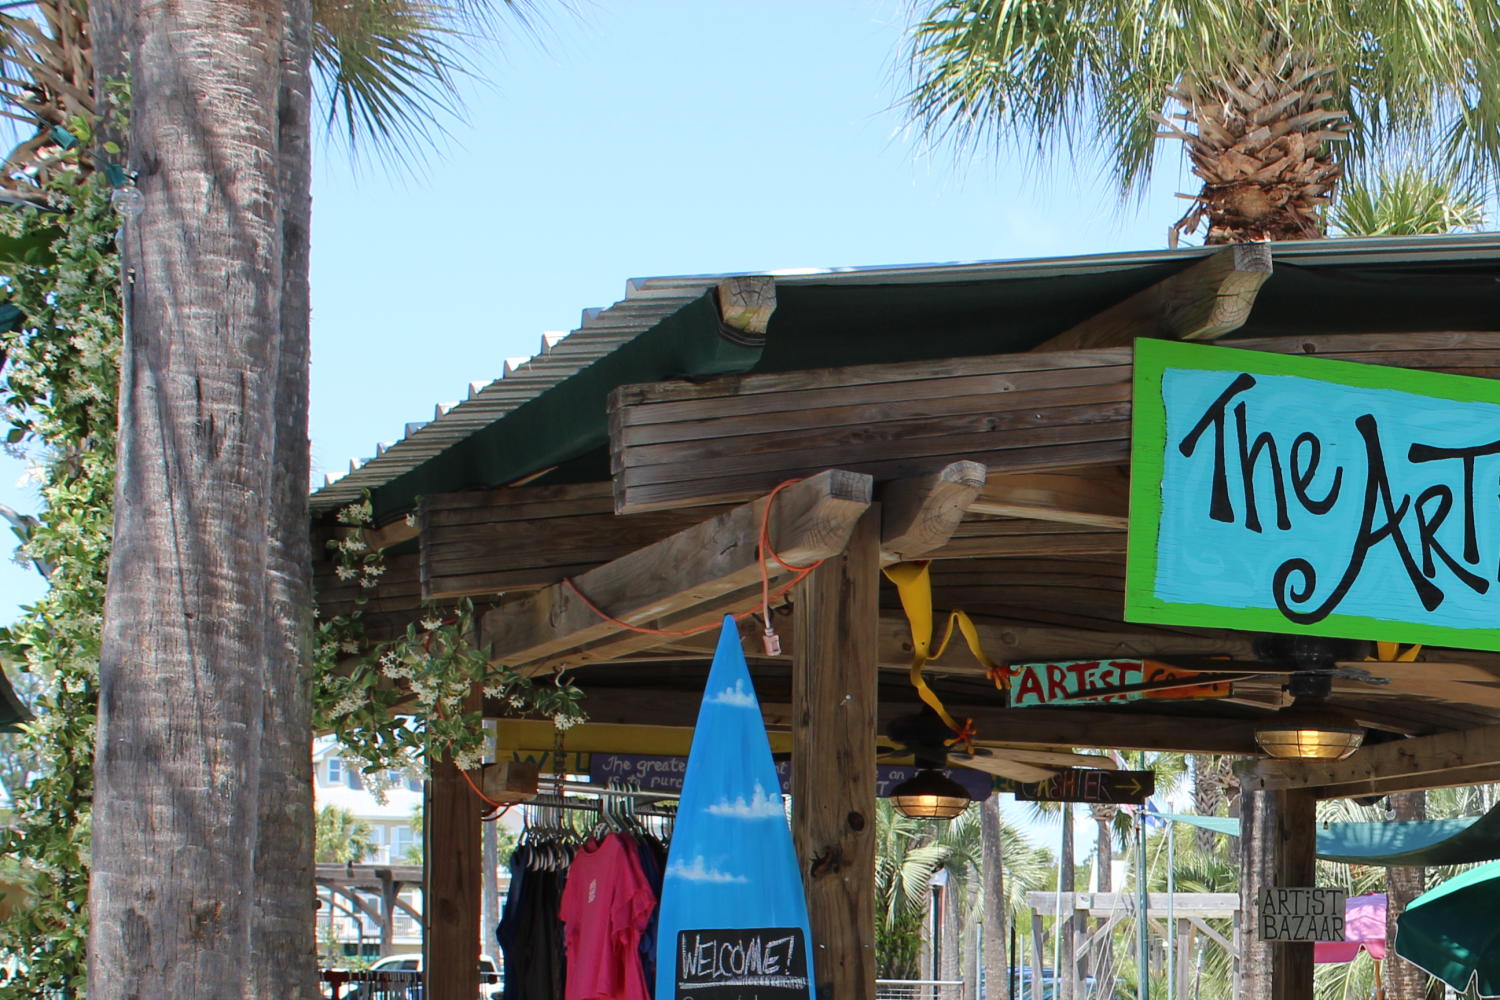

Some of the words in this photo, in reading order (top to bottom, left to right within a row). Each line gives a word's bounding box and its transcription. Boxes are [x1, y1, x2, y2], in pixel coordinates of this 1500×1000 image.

[1180, 373, 1342, 533] The
[602, 756, 631, 775] The
[1264, 915, 1345, 942] BAZAAR
[680, 933, 795, 980] WELCOME!
